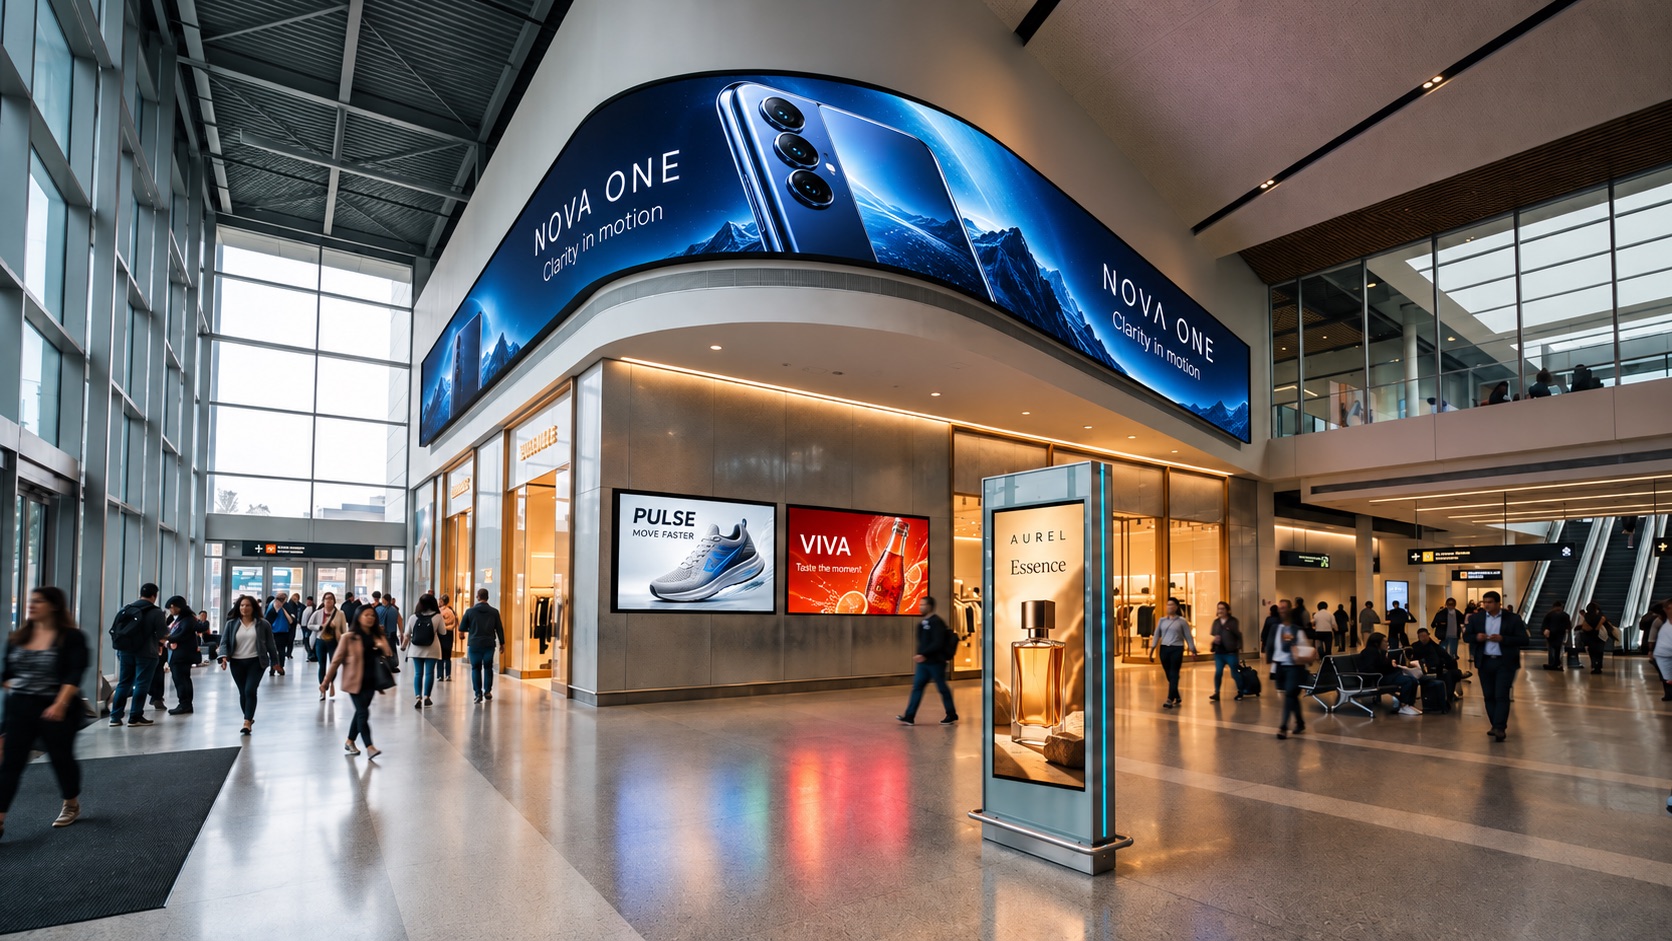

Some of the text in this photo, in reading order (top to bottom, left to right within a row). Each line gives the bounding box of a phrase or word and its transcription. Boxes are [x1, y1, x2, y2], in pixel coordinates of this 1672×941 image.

[534, 149, 680, 257] NOVA ONE
[542, 205, 664, 282] Clarity in motion
[1112, 310, 1201, 381] Clarity in motion
[1176, 317, 1214, 363] ONE
[633, 507, 697, 527] PULSE
[632, 529, 695, 540] MOVE FASTER
[799, 533, 852, 557] VIVA
[1010, 530, 1067, 545] AUREL
[796, 562, 863, 574] Taste the moment
[1010, 559, 1067, 575] Essence
